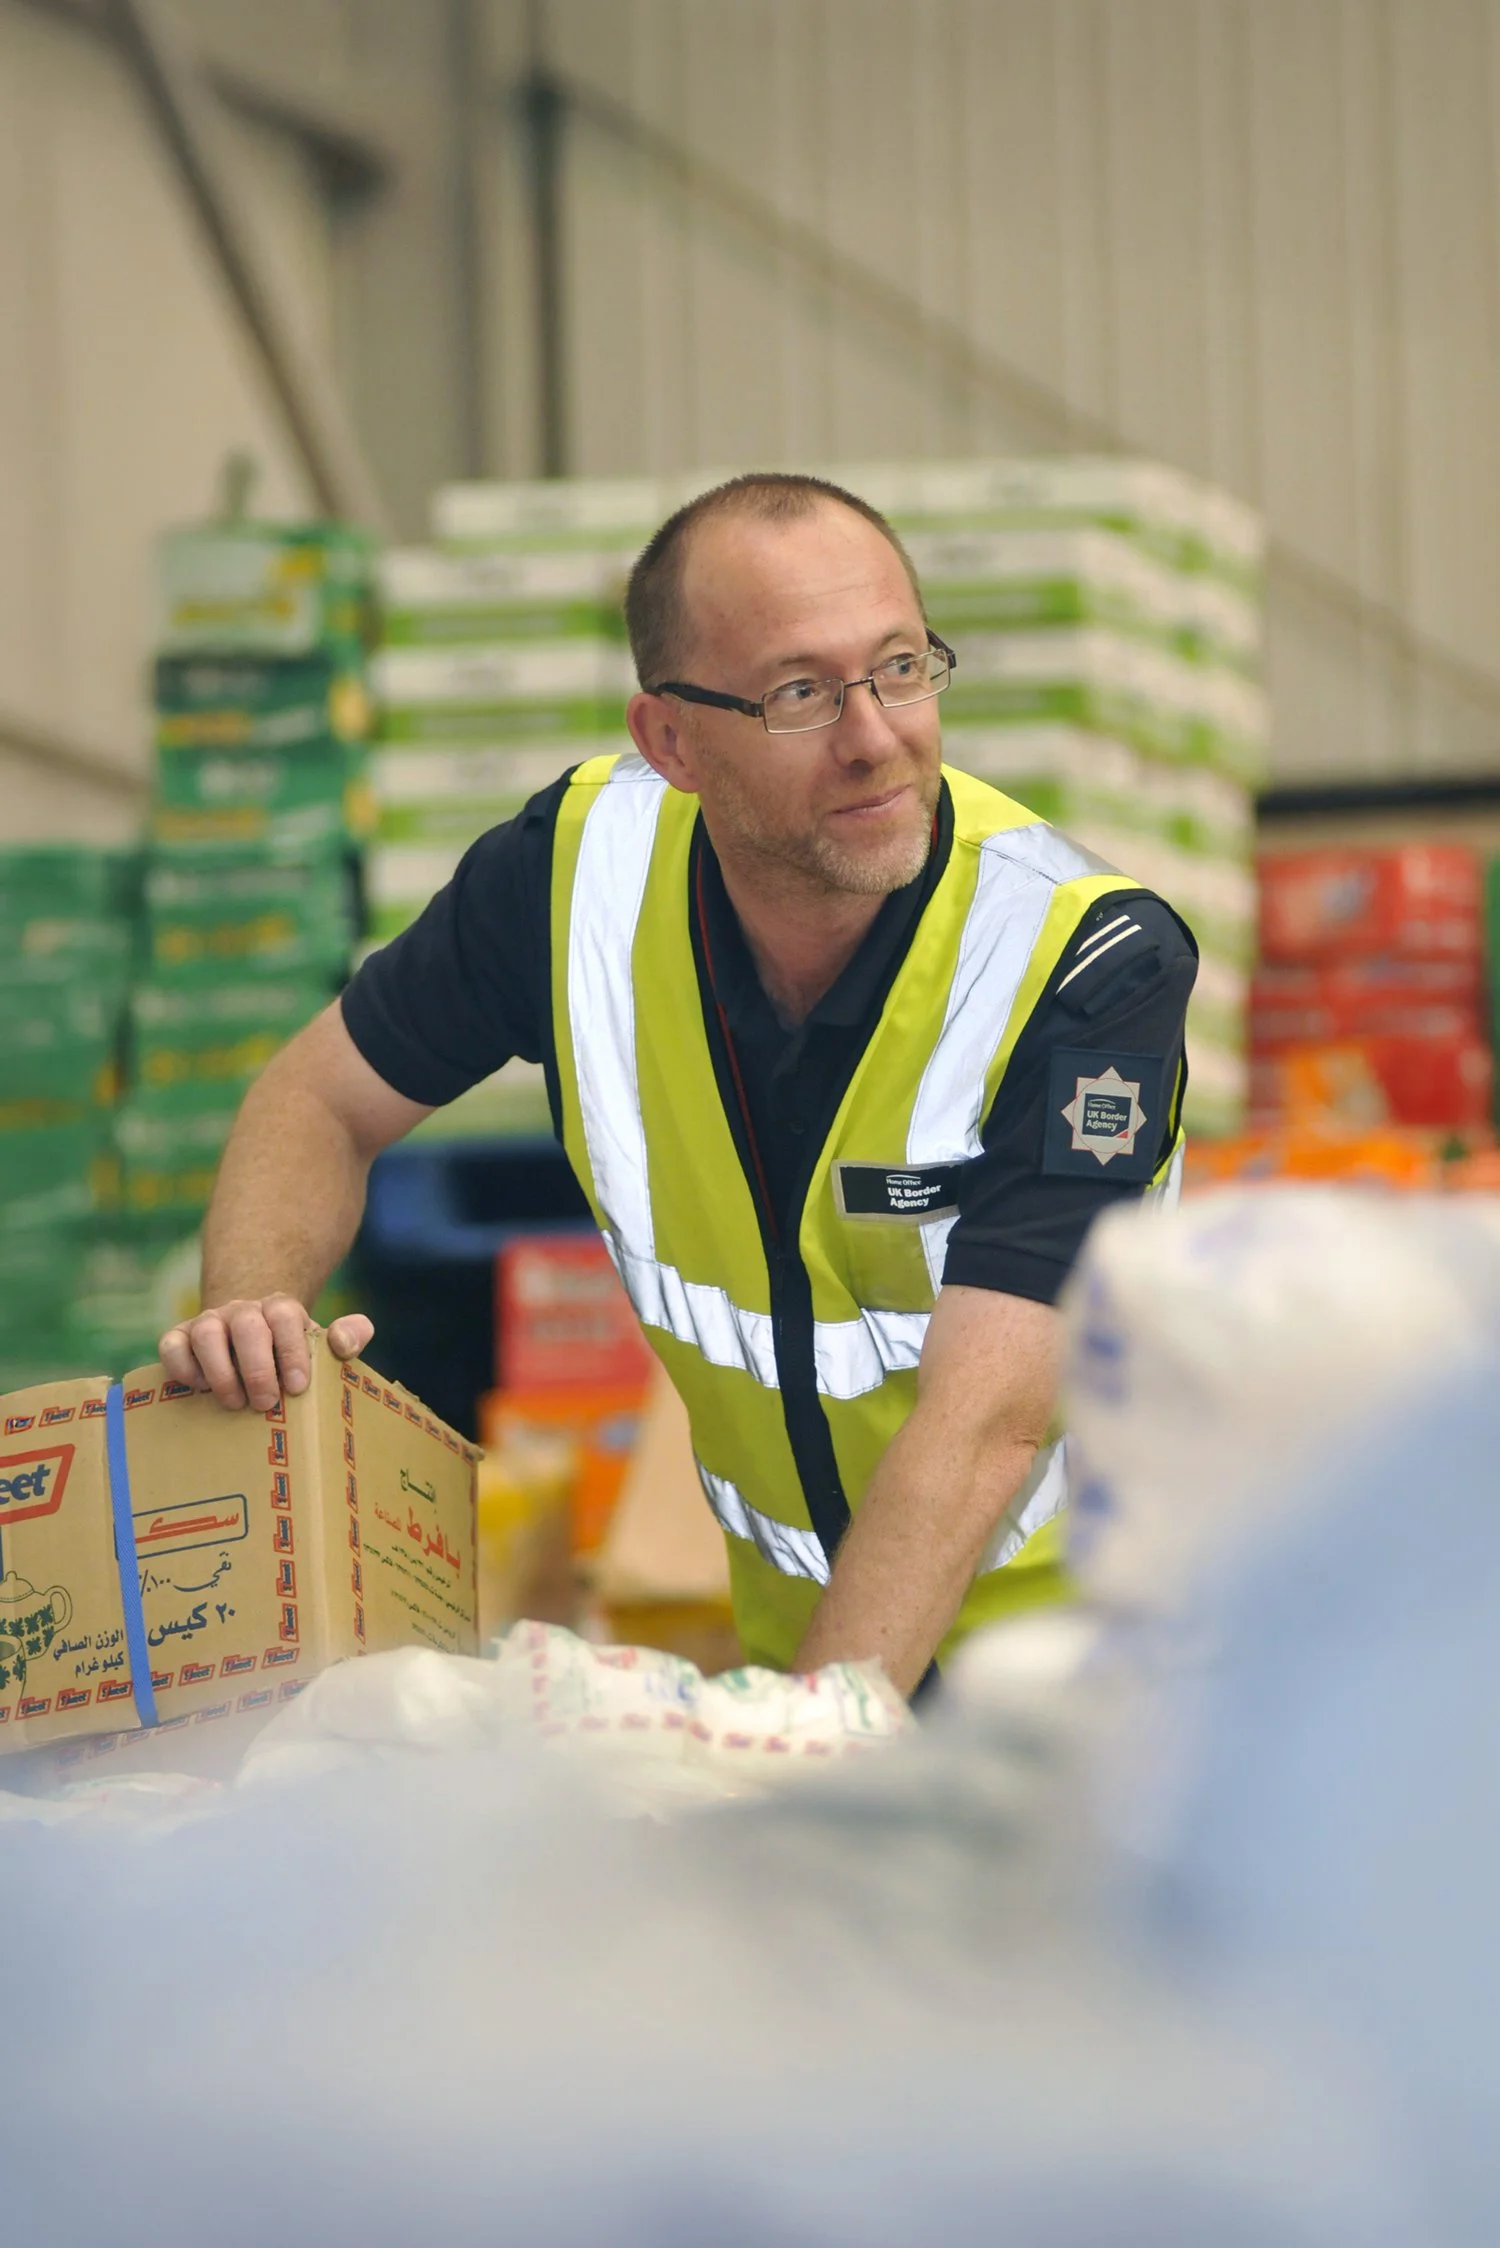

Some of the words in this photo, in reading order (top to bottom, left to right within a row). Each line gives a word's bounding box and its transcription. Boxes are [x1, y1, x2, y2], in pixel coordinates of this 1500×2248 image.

[1087, 1110, 1099, 1118] UK
[1100, 1111, 1128, 1121] Border
[1086, 1120, 1118, 1132] Agency
[888, 1187, 903, 1197] UK
[904, 1185, 942, 1198] Border
[890, 1197, 929, 1209] Agency
[148, 1602, 208, 1647] كيس
[96, 1629, 124, 1650] الوزن
[53, 1636, 92, 1660] الصافي
